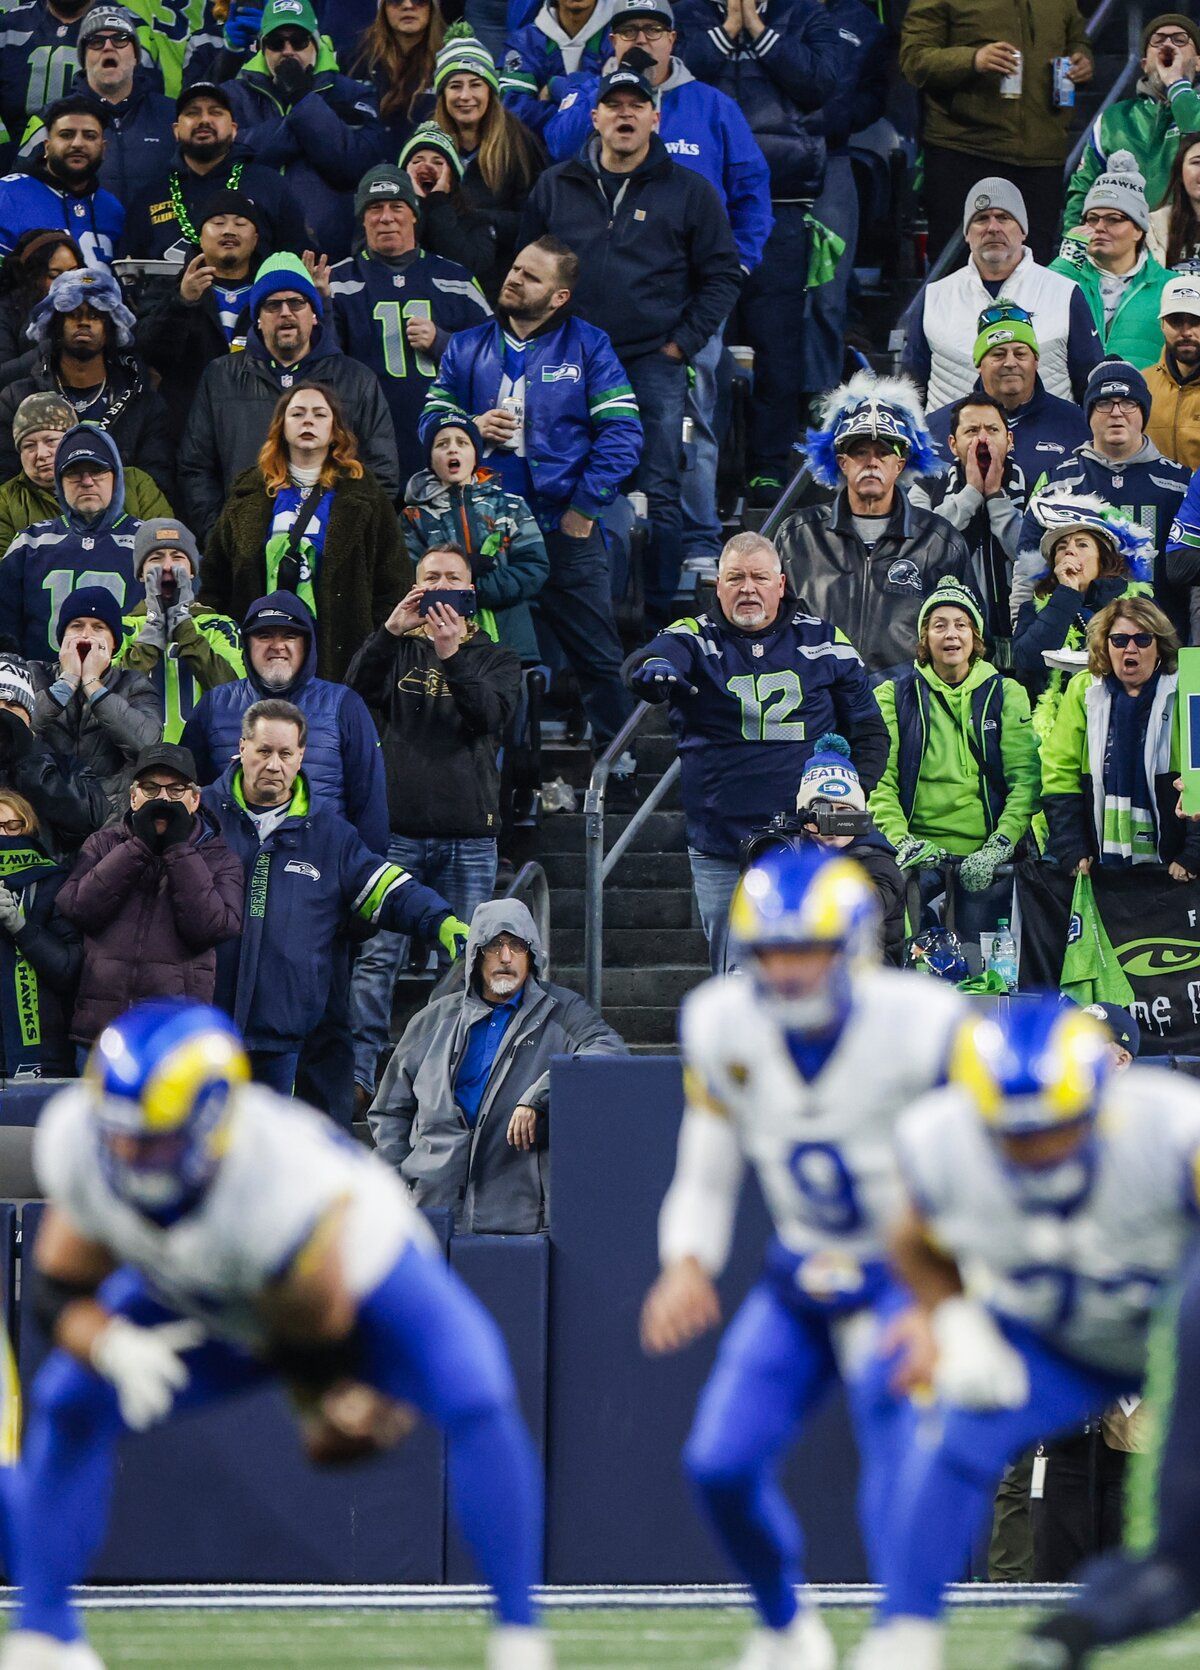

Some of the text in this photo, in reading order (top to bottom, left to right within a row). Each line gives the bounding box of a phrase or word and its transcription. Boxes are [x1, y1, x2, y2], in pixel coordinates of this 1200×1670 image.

[726, 669, 805, 741] 12
[803, 767, 859, 785] SEATTLE
[17, 965, 38, 1041] HAWKS
